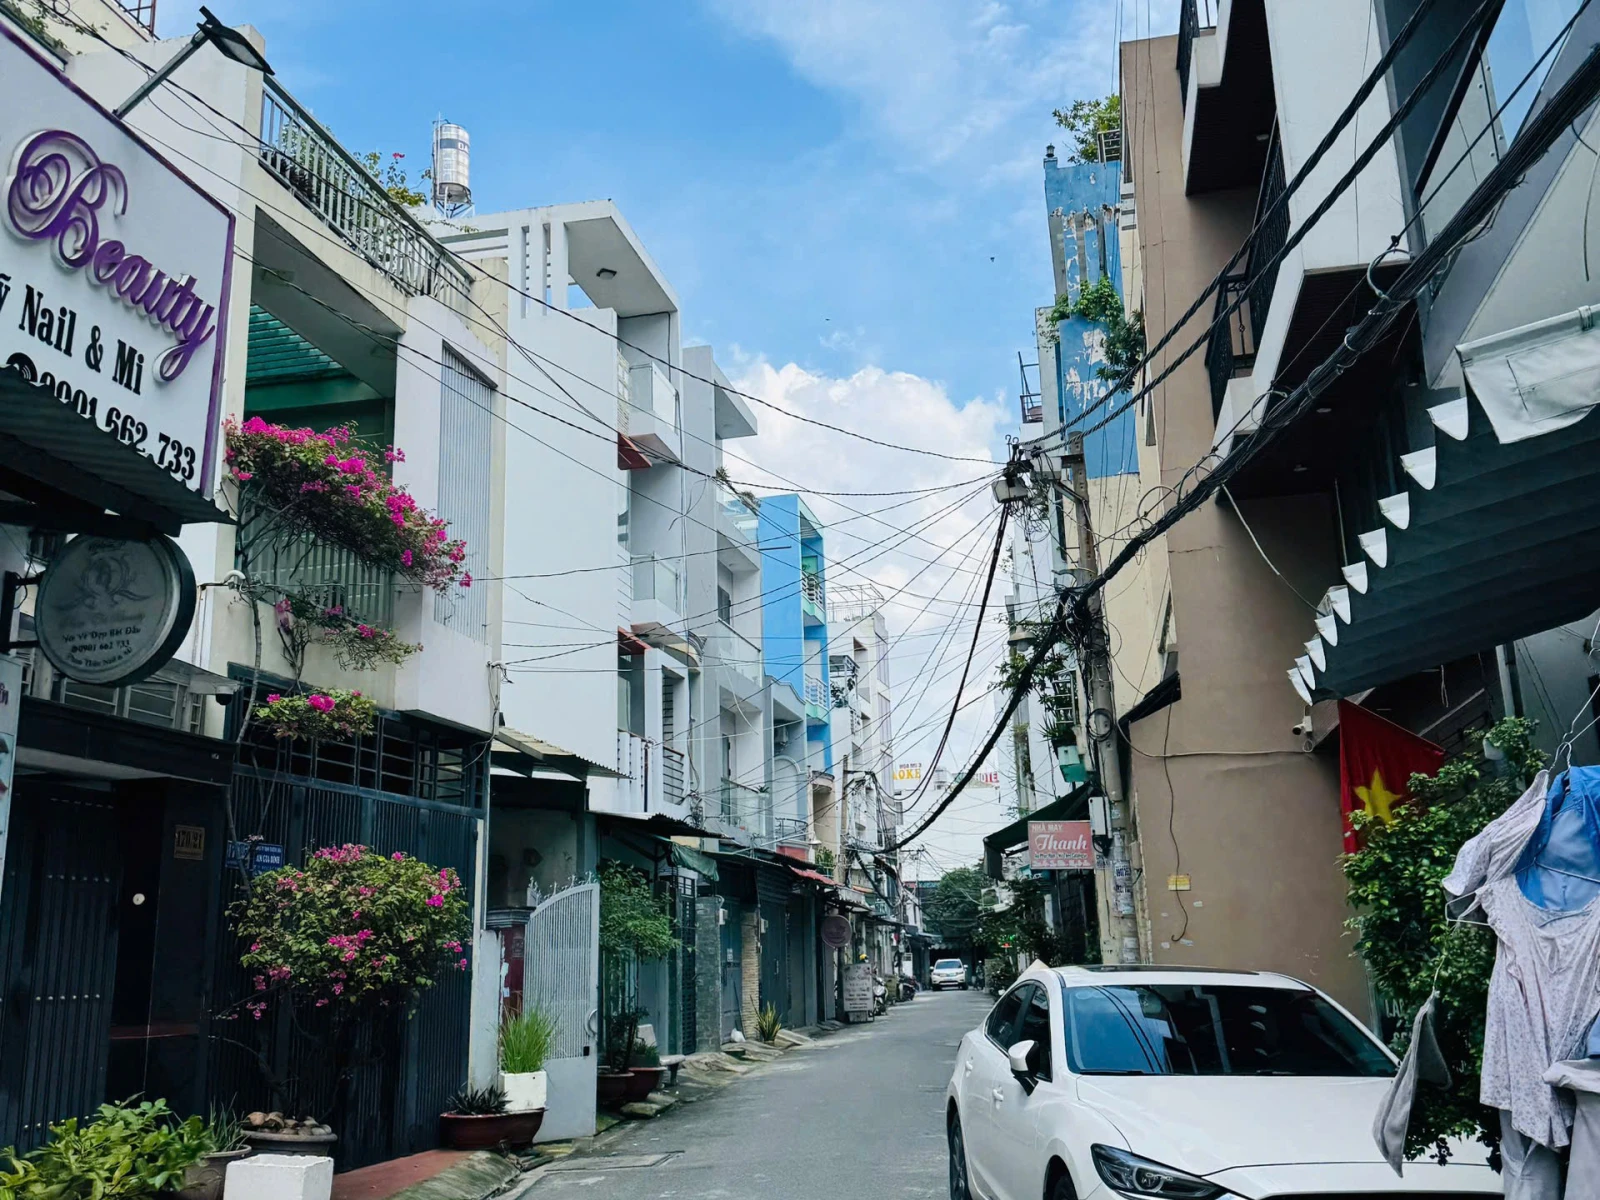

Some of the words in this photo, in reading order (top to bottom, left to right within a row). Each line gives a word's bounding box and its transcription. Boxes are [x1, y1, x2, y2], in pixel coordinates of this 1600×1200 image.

[3, 129, 216, 382] Beauty
[18, 285, 77, 357] Nail
[84, 325, 104, 373] &
[111, 338, 145, 396] Mi
[157, 432, 197, 481] 733
[1034, 834, 1087, 851] Thanh
